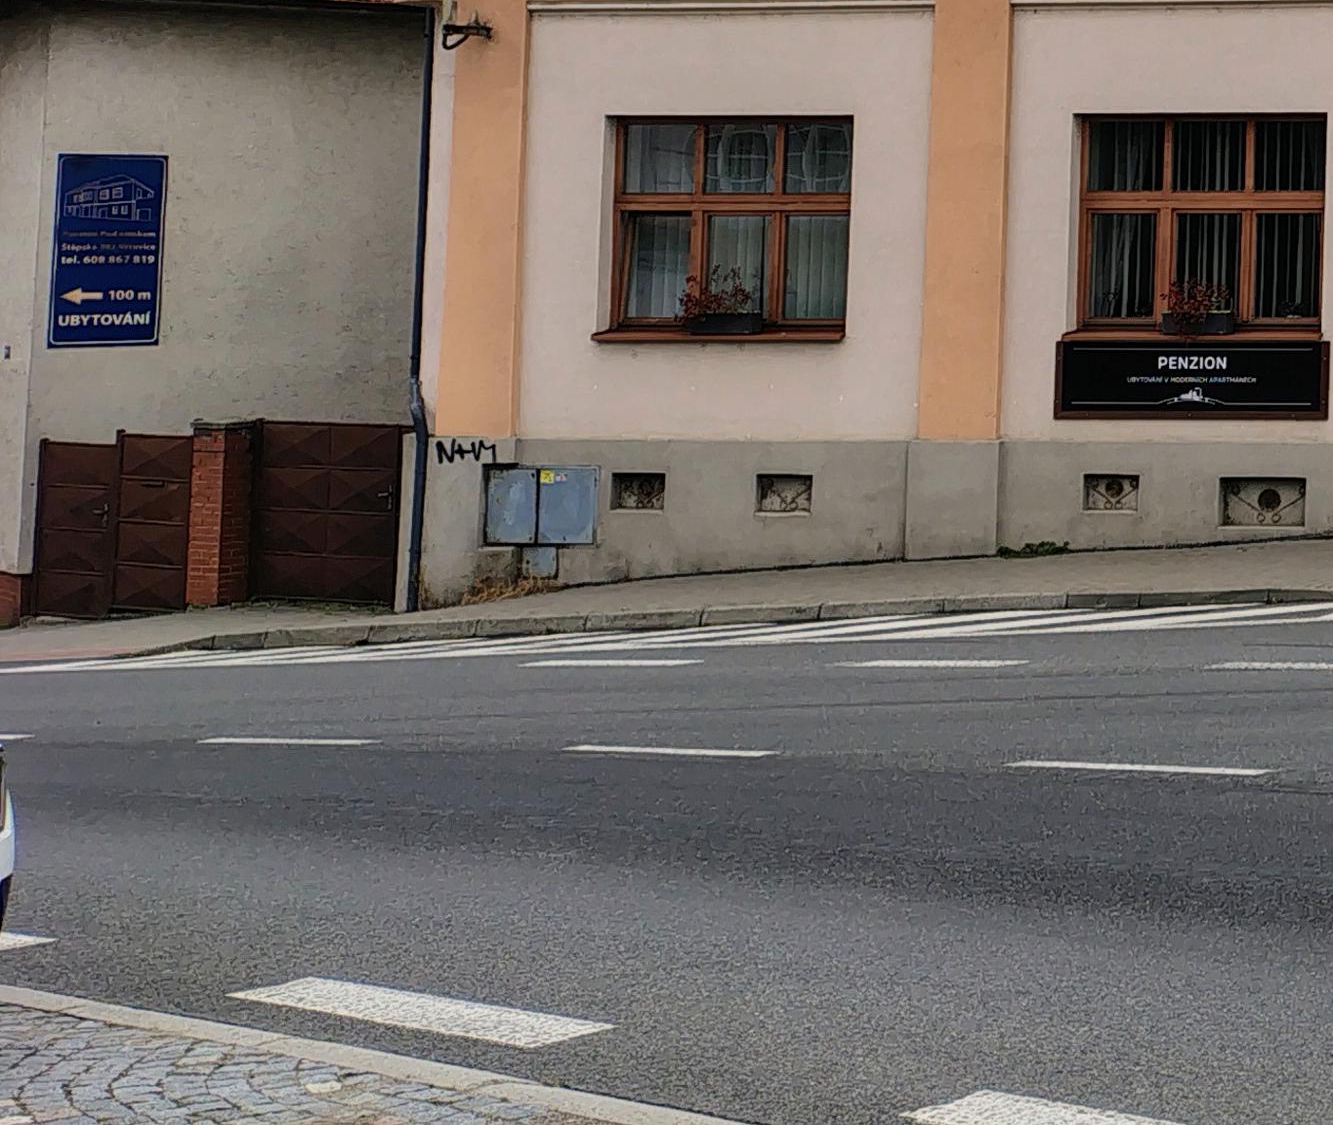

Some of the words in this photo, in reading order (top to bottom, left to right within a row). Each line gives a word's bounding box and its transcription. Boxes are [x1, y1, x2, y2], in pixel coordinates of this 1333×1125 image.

[108, 290, 135, 300] 100
[137, 291, 151, 300] m
[58, 311, 152, 326] UBYTOVÁNÍ
[1158, 356, 1228, 370] PENZION
